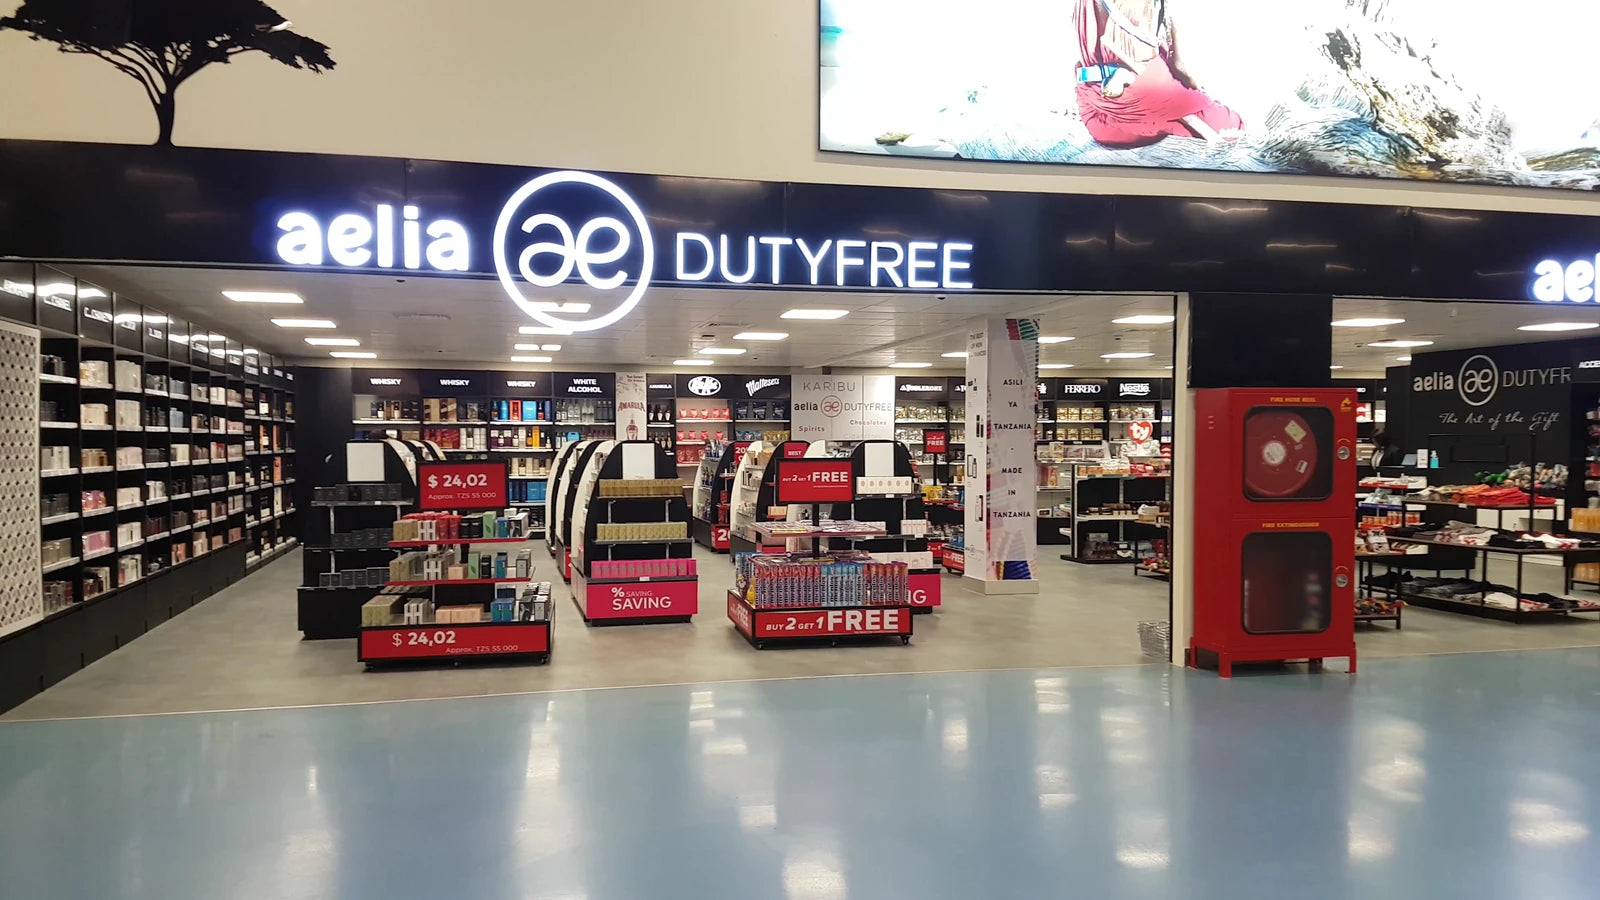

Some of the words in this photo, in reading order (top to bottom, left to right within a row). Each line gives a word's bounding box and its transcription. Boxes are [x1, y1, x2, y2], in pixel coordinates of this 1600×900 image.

[277, 204, 469, 271] aelia
[676, 232, 973, 289] DUTYFREE
[506, 380, 536, 388] WHISKY
[803, 382, 856, 392] KARIBU
[1413, 372, 1454, 392] aelia
[1064, 384, 1101, 393] FERRERO
[794, 402, 818, 411] aelia
[844, 402, 892, 411] DUTYFREE
[1439, 412, 1458, 424] The
[1488, 412, 1502, 430] of
[1504, 411, 1524, 423] the
[1528, 412, 1560, 431] Gift
[798, 425, 825, 433] Spirits
[427, 474, 438, 488] $
[443, 473, 487, 488] 24,02
[812, 471, 848, 482] FREE
[611, 587, 625, 598] %
[612, 596, 672, 610] SAVING
[766, 623, 785, 631] BUY
[785, 617, 797, 631] 2
[797, 622, 815, 630] GET
[815, 616, 824, 630] 1
[827, 609, 899, 632] FREE
[392, 632, 402, 647] $
[407, 630, 456, 646] 24,02
